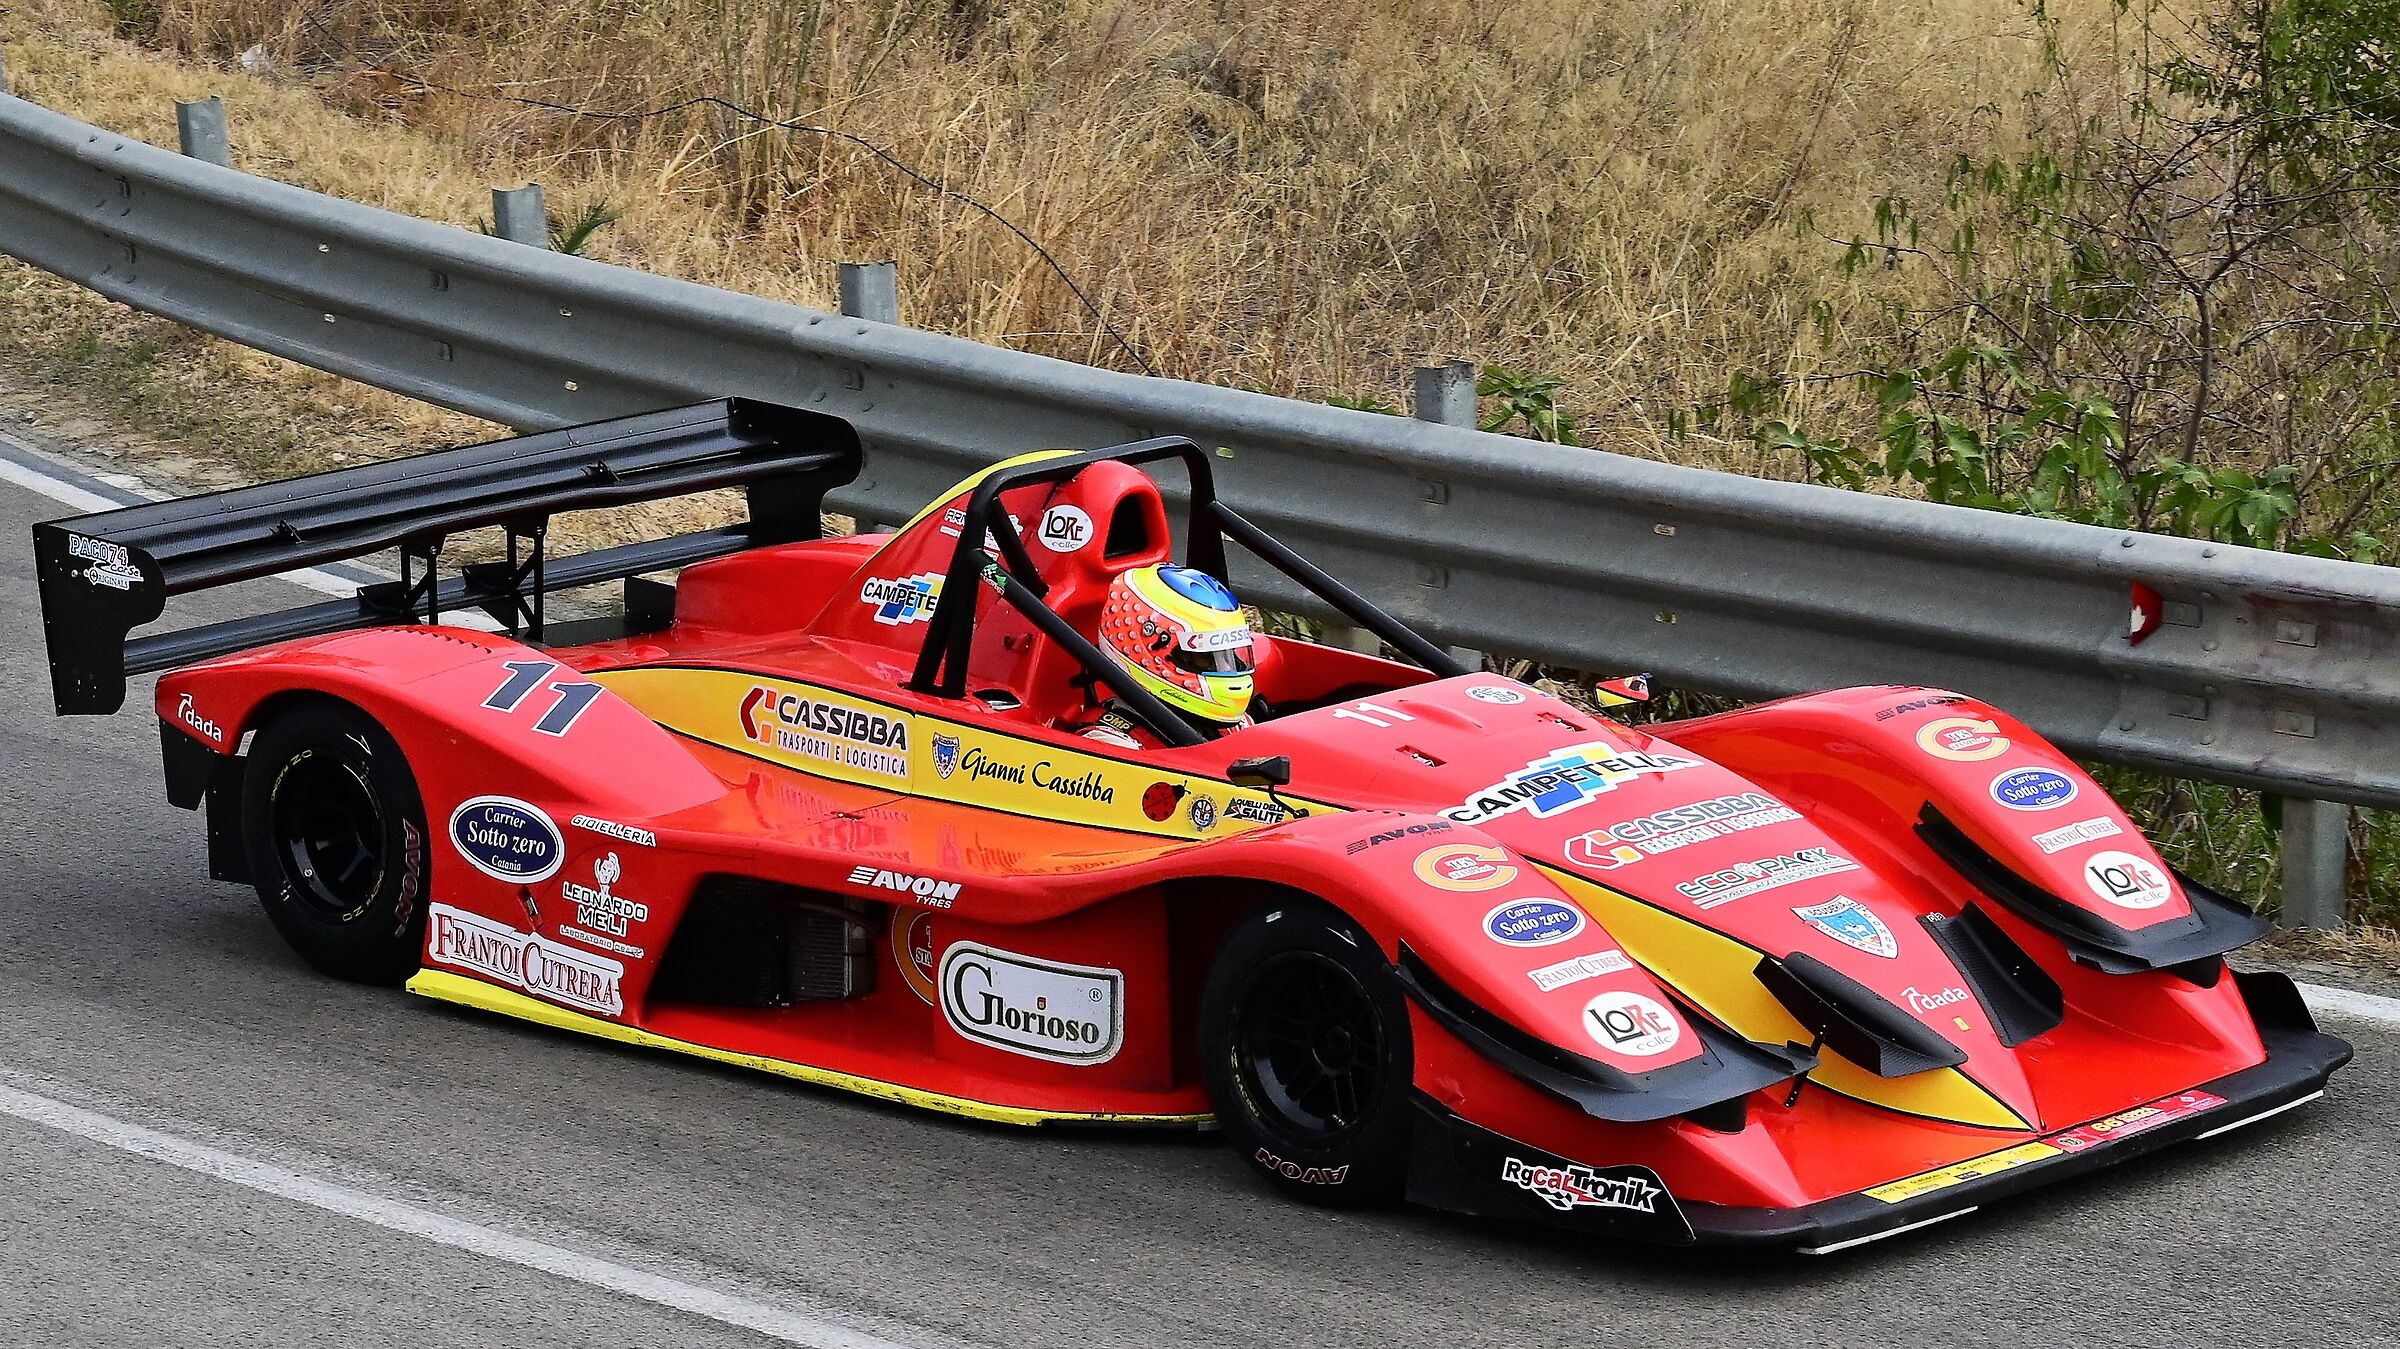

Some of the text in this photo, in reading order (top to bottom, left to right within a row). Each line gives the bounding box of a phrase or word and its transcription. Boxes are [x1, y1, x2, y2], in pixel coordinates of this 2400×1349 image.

[70, 535, 128, 566] PACO74
[863, 581, 938, 612] CAMPETE
[480, 660, 607, 738] 11
[778, 695, 907, 750] CASSIBBA
[1102, 713, 1131, 731] OMP
[1332, 702, 1415, 728] 11
[777, 730, 831, 761] TRASPORTI
[834, 746, 841, 762] E
[846, 748, 906, 776] LOGISTICA
[960, 747, 1025, 785] Gianni
[1031, 761, 1114, 805] Cassibba
[1448, 752, 1690, 823] CAMPETELLA
[2005, 778, 2065, 802] Sotto zero
[2008, 773, 2040, 786] Carrier
[484, 807, 526, 829] Carrier
[1241, 807, 1285, 824] SALITE
[1262, 801, 1286, 813] DELL
[1613, 795, 1778, 841] CASSIBBA
[467, 820, 546, 858] Sotto zero
[571, 815, 656, 847] GIOIELLERIA
[1369, 821, 1451, 847] AVON
[491, 854, 522, 872] Catania
[871, 870, 962, 900] AVON
[2089, 863, 2163, 897] LORE
[563, 883, 647, 921] LEONARDO
[915, 894, 952, 909] TYRES
[1505, 904, 1543, 921] Carrier
[577, 904, 628, 936] MELI
[1499, 909, 1570, 939] Sotto zero
[436, 912, 616, 1006] FRANTOI CUTRERA
[1578, 953, 1629, 979] CUTRERA
[954, 962, 1100, 1044] Glorioso
[1587, 1003, 1672, 1044] LORE
[1255, 1147, 1349, 1185] AVON
[1504, 1159, 1660, 1211] RgcarTronik
